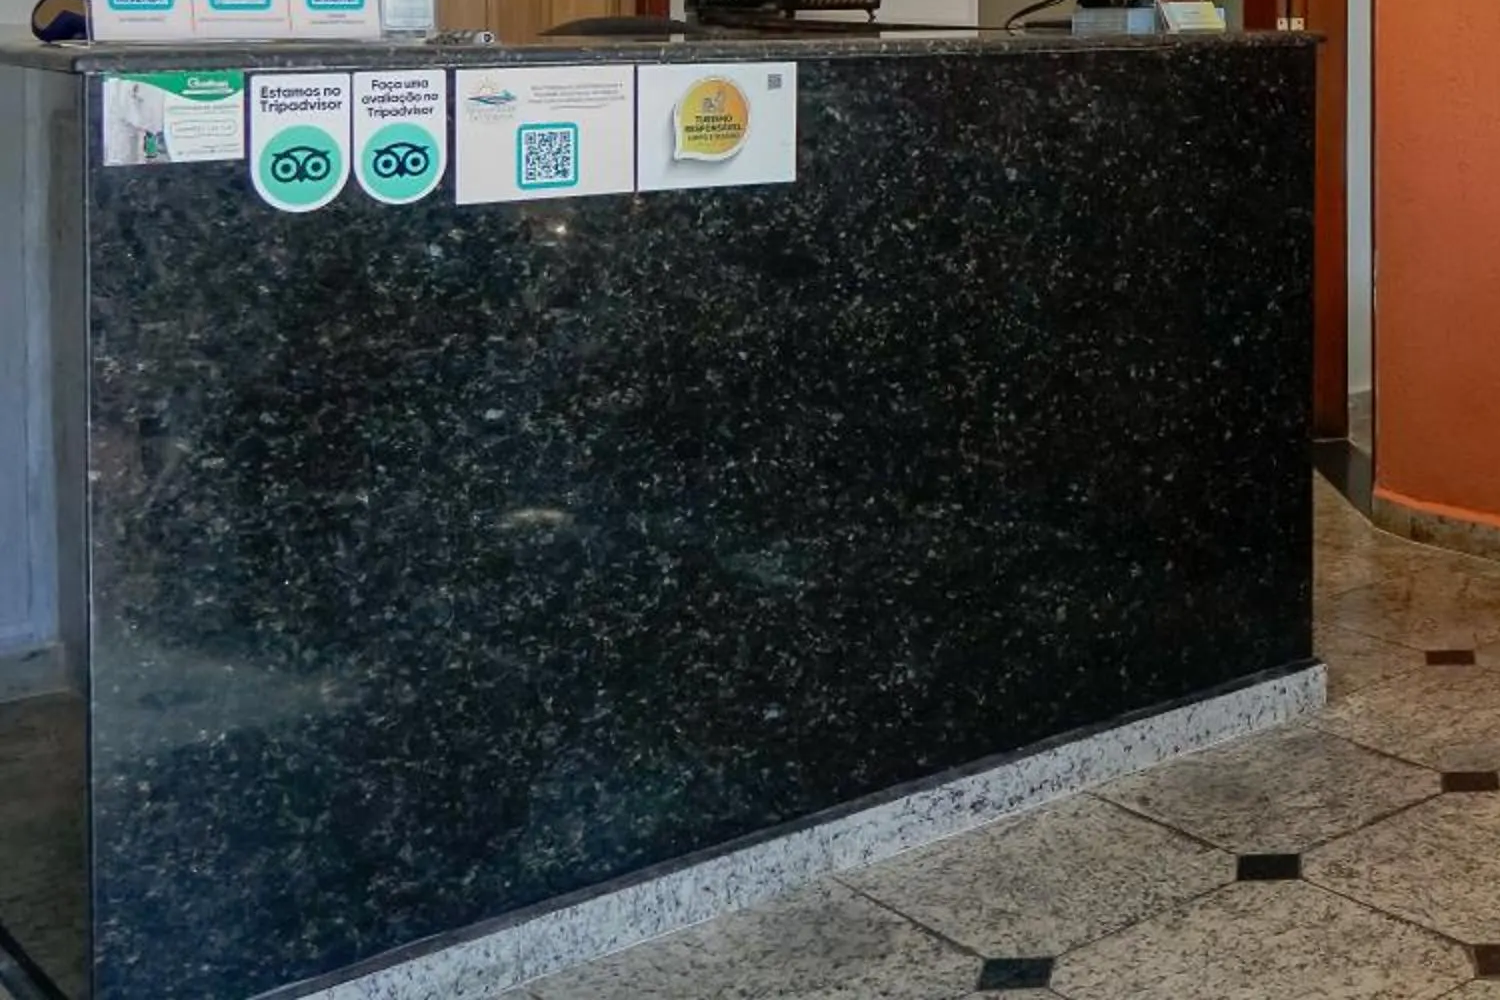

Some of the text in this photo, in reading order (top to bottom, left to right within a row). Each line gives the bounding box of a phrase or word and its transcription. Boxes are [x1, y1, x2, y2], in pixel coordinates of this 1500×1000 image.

[259, 86, 342, 99] Estamos no
[371, 79, 429, 93] Faça uma
[361, 91, 423, 105] avaliação
[259, 97, 343, 114] Tripadvisor
[367, 105, 434, 119] Tripadvisor
